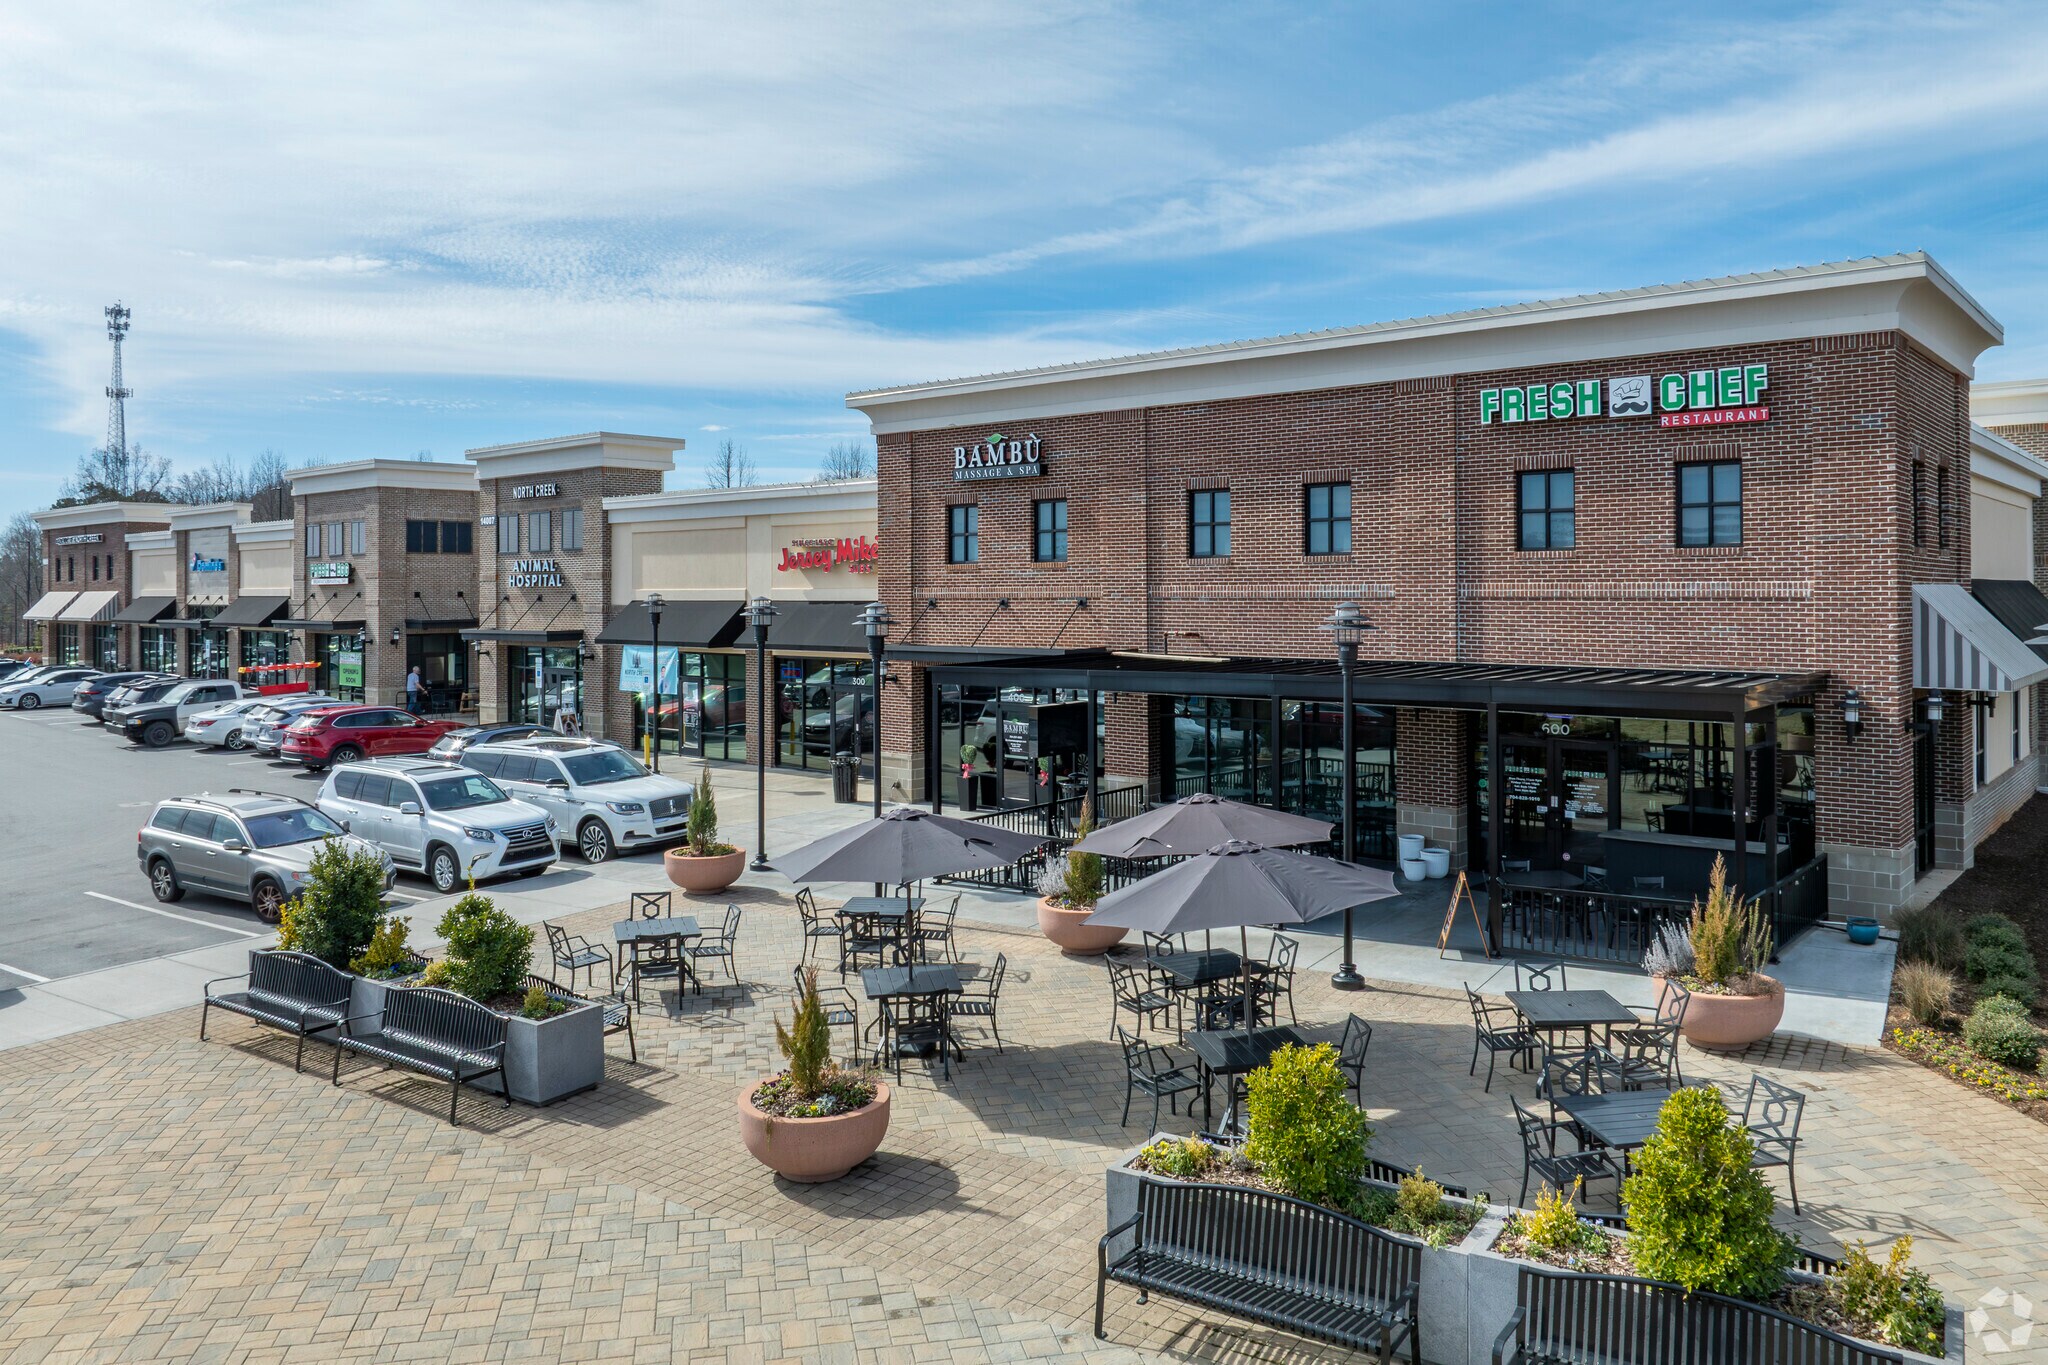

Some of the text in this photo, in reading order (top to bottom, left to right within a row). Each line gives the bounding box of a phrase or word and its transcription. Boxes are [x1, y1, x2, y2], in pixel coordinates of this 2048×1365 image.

[1480, 364, 1768, 425] FRESH CHEF
[1661, 409, 1768, 426] RESTAURANT
[954, 433, 1041, 469] BAMBÙ
[955, 465, 1038, 480] MASSAGE & SPA
[513, 483, 557, 499] NORTH CREEK
[480, 516, 495, 526] 14007
[513, 559, 556, 572] ANIMAL
[777, 547, 833, 573] Jersey
[508, 573, 562, 588] HOSPITAL
[852, 677, 866, 686] 300
[1008, 693, 1025, 703] 400
[1541, 723, 1570, 736] 600
